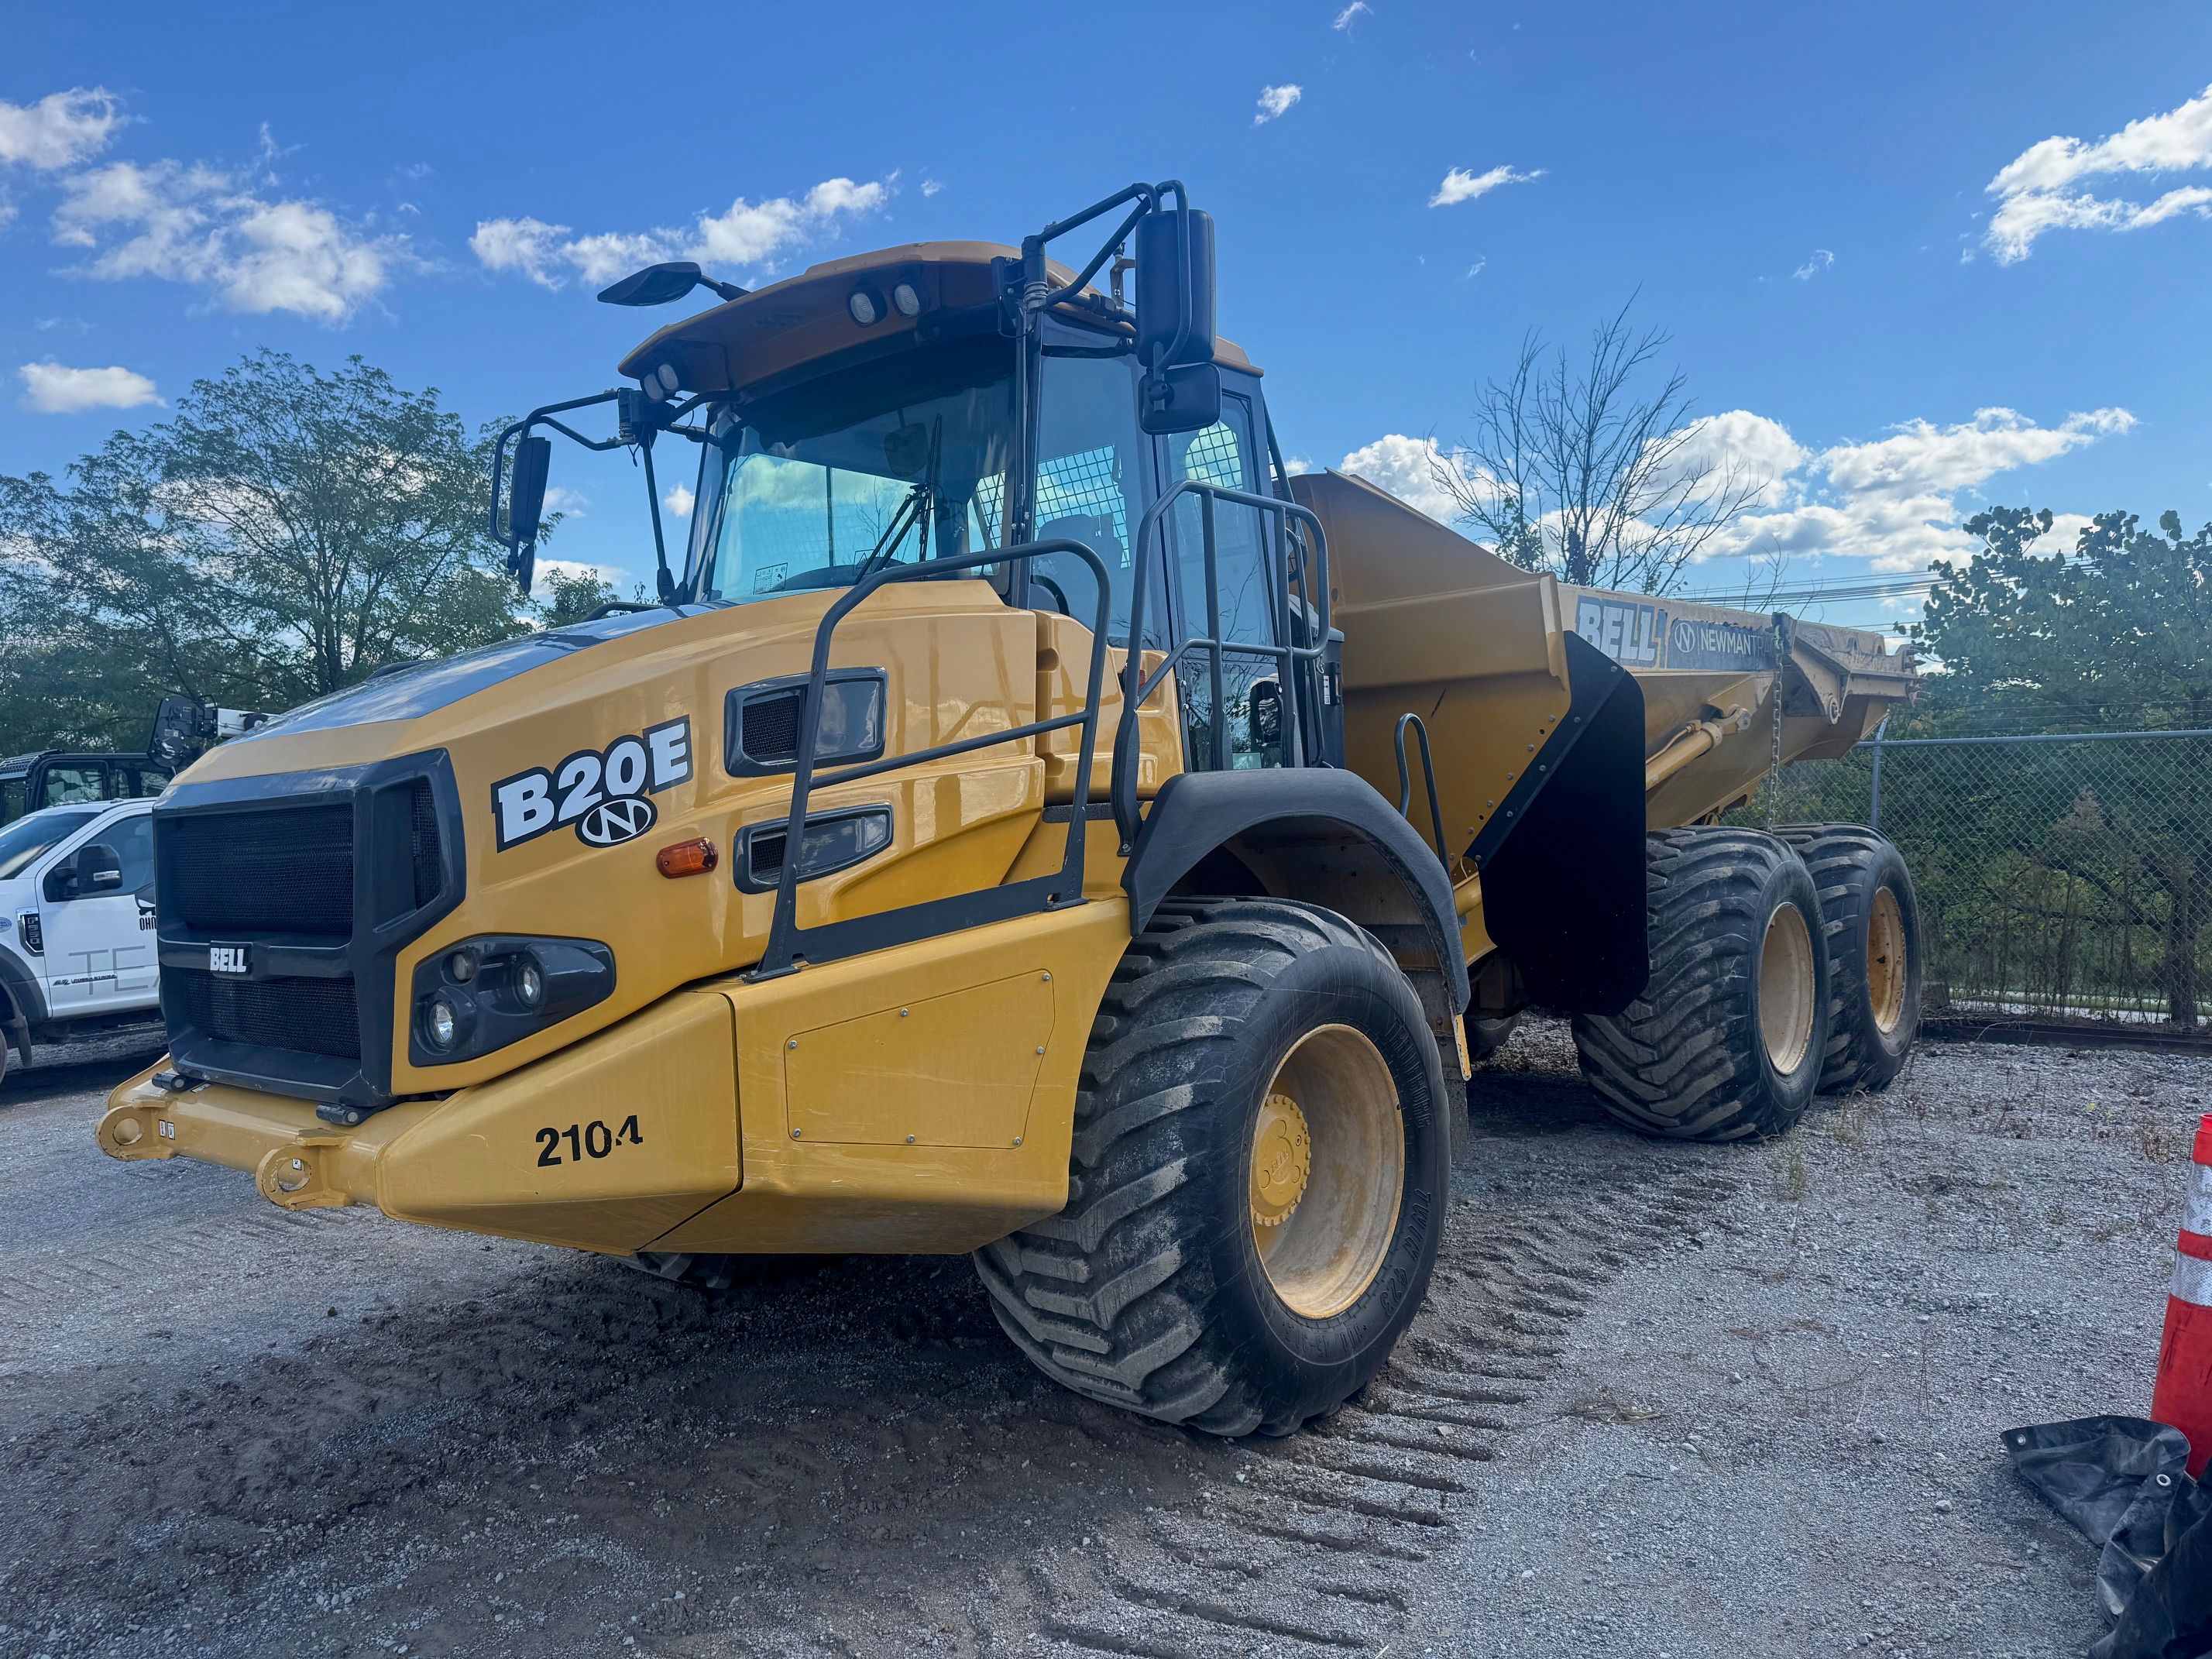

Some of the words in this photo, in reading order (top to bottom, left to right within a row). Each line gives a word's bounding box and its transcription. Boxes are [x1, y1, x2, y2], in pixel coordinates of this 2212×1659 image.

[1578, 603, 1655, 661] BELL
[496, 721, 689, 844] B20E
[68, 945, 160, 996] TE
[210, 947, 247, 973] BELL
[535, 1115, 644, 1167] 2104
[1403, 1188, 1432, 1262] TWIN
